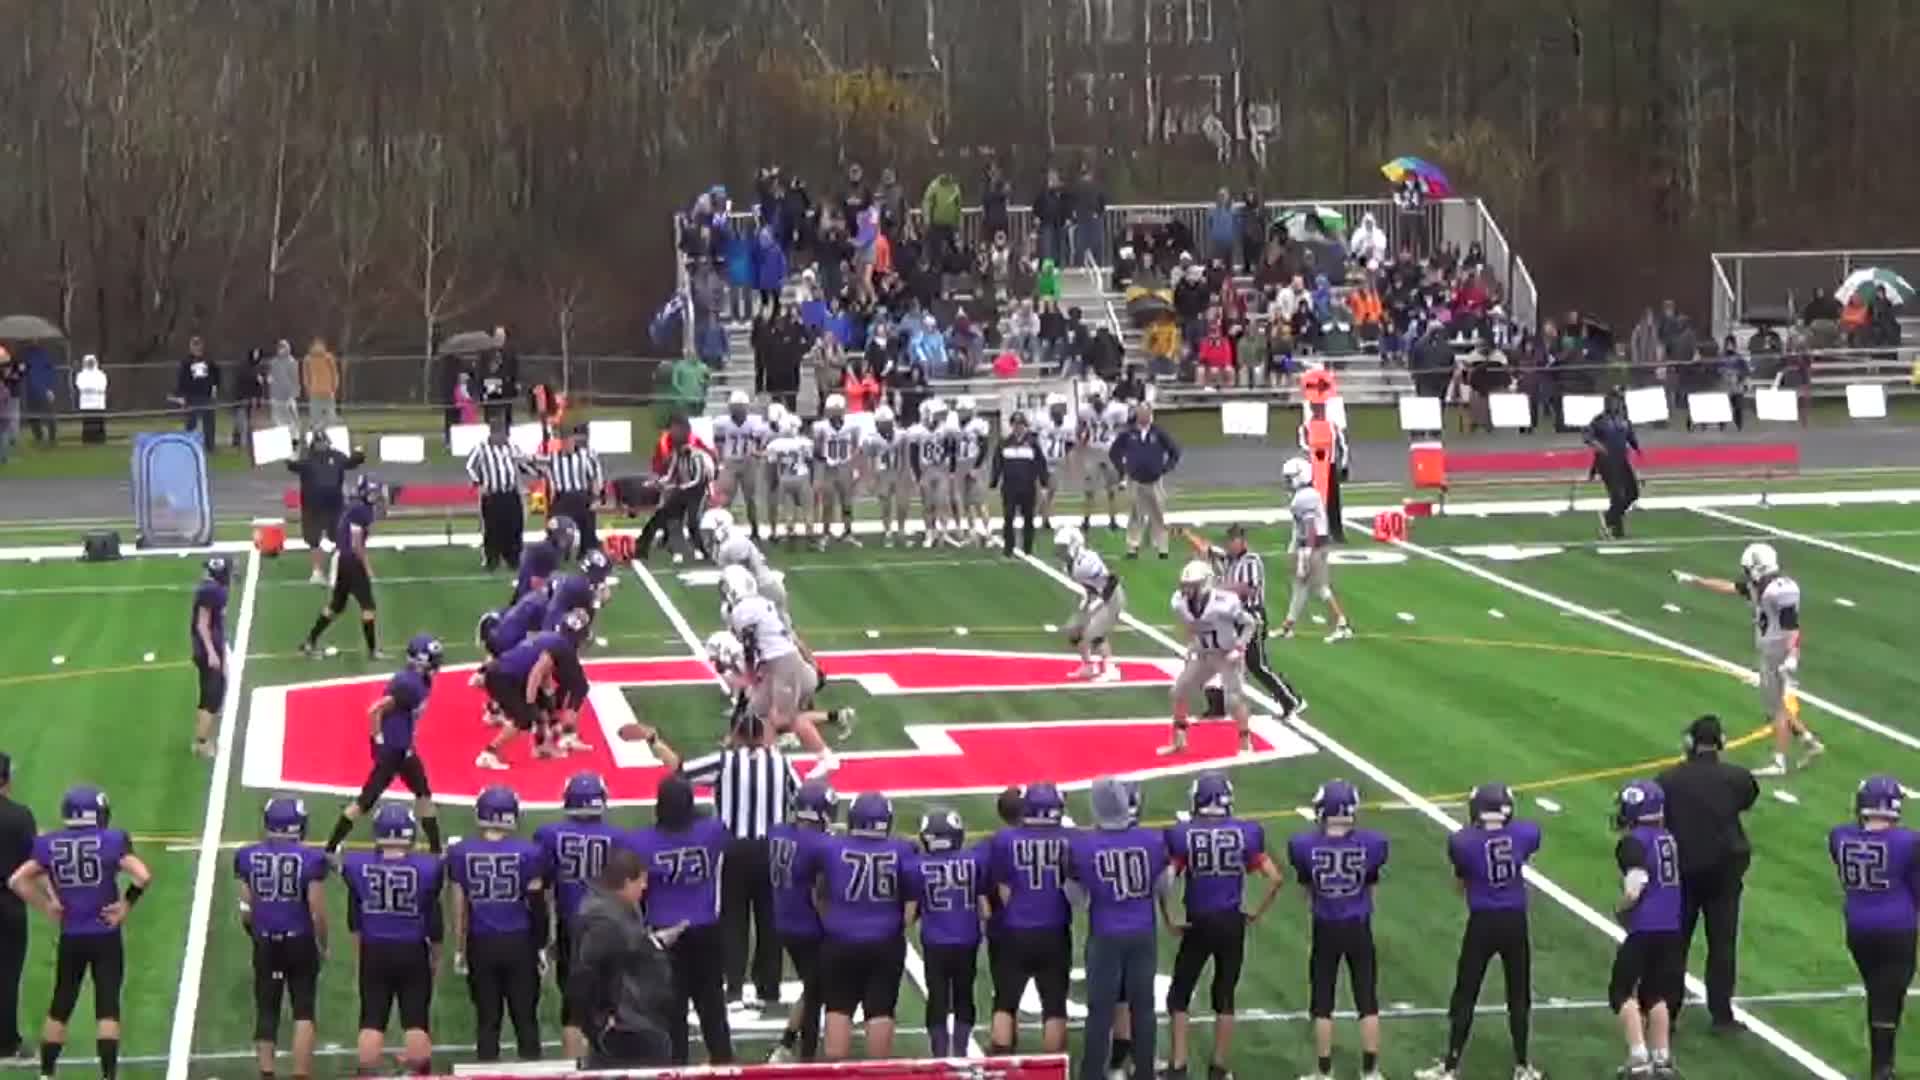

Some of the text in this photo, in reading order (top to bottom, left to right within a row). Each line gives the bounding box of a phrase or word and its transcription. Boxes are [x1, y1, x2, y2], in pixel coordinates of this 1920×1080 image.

[1375, 512, 1402, 538] 40
[49, 838, 102, 886] 26
[249, 852, 302, 901] 28
[465, 852, 520, 902] 55
[557, 831, 612, 885] 50
[655, 846, 711, 884] 73
[842, 848, 898, 901] 76
[1013, 838, 1069, 889] 44
[1096, 847, 1150, 899] 40
[1186, 828, 1245, 876] 82
[1312, 847, 1366, 896] 25
[1485, 838, 1516, 888] 6
[1655, 834, 1680, 887] 8
[1840, 840, 1889, 891] 62
[362, 863, 418, 916] 32
[921, 858, 977, 912] 24
